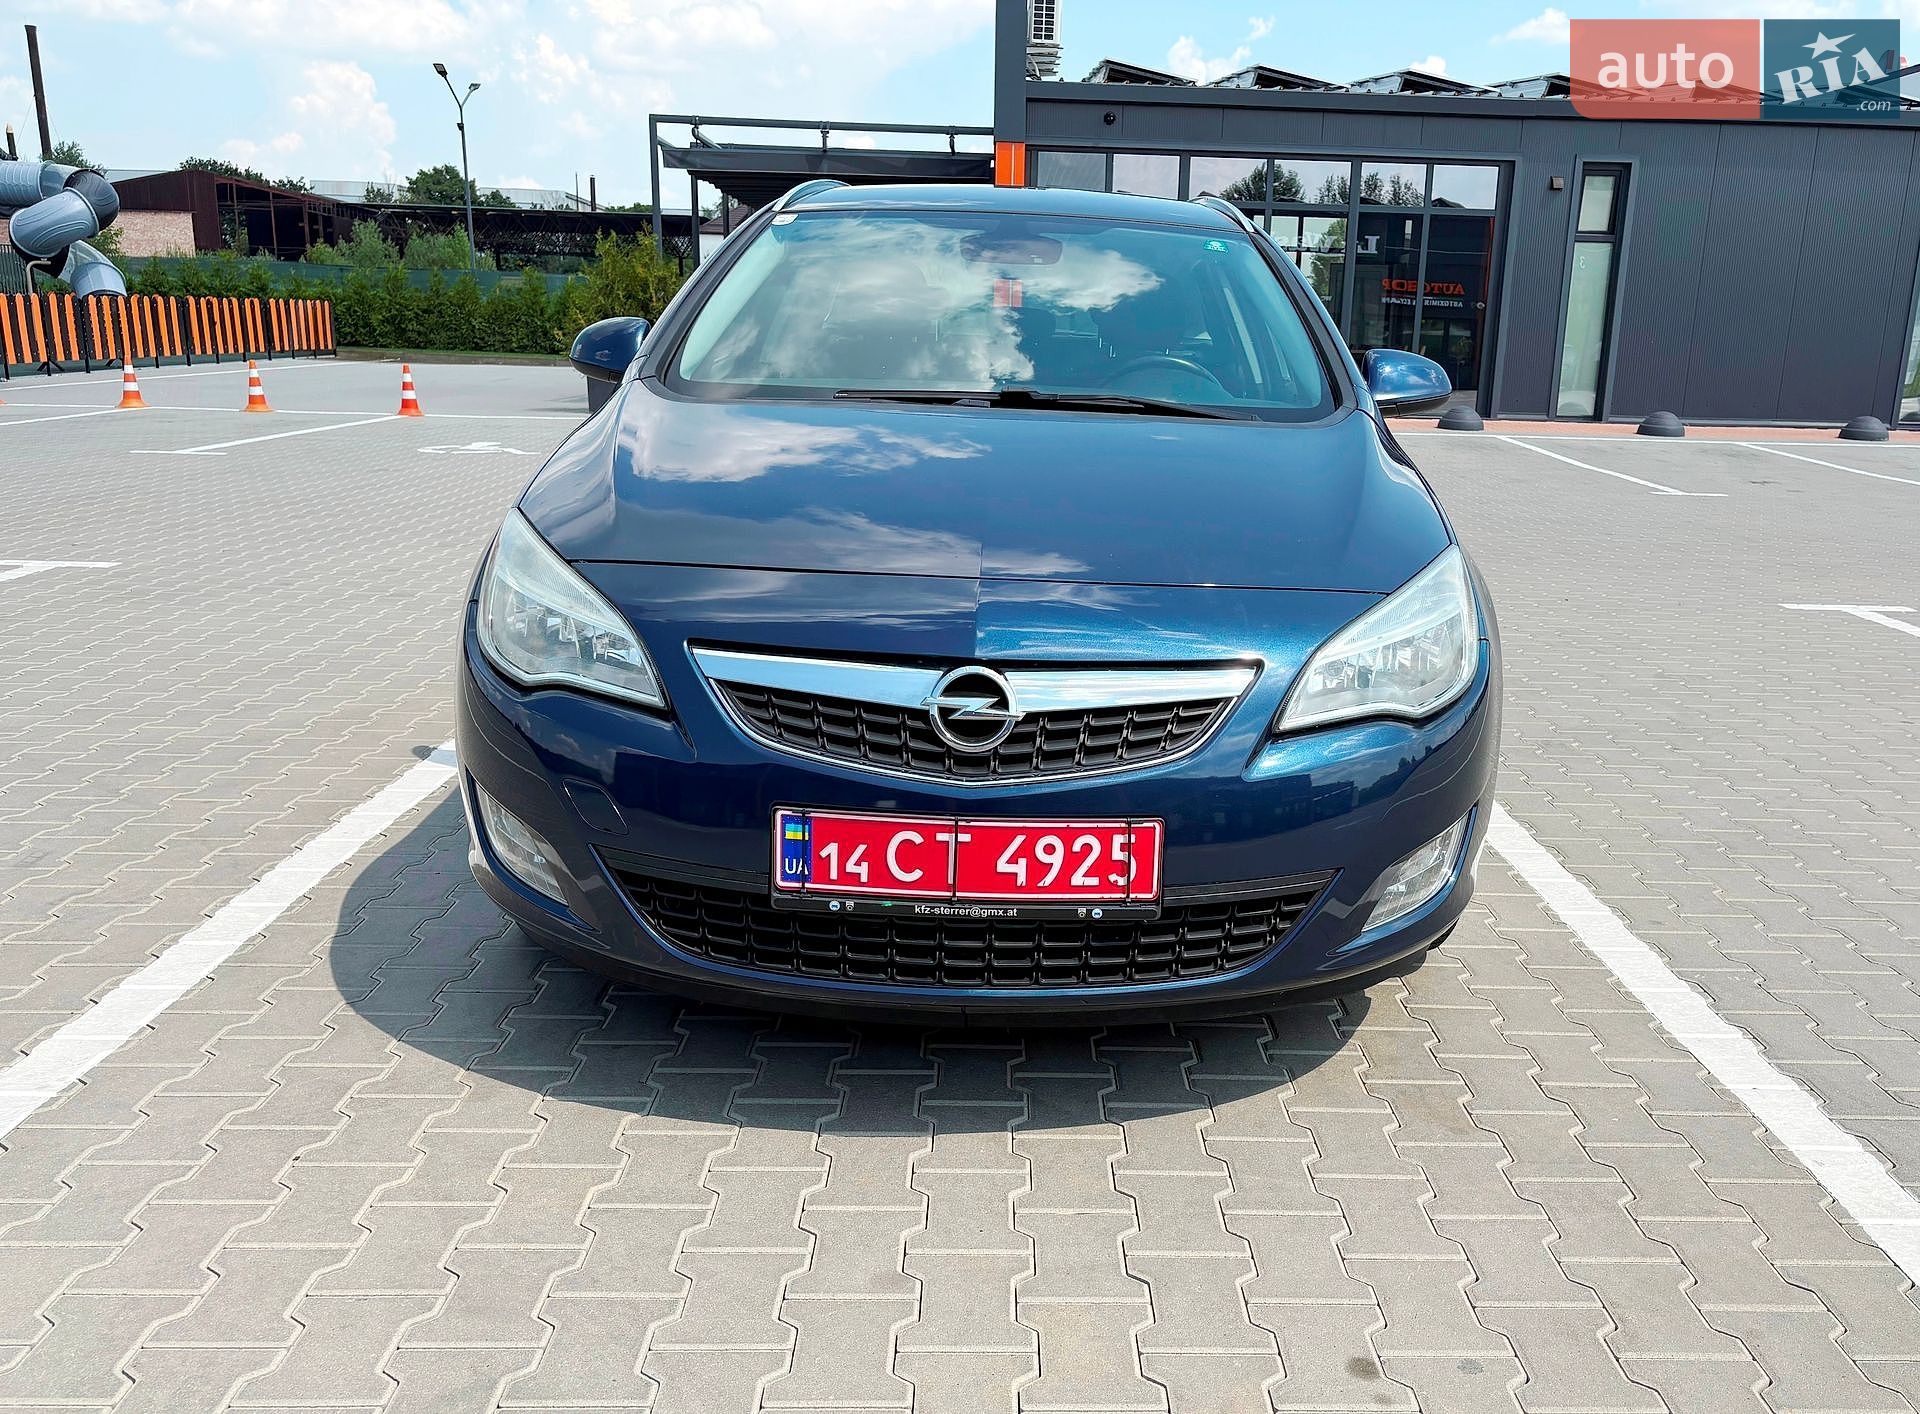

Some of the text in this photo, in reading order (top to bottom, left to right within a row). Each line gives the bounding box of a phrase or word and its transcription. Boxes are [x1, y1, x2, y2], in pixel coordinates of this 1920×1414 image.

[784, 857, 809, 875] UA
[818, 830, 1137, 888] 14 CT 4925
[914, 904, 1018, 918] kfz-sterrer@gmx.at
